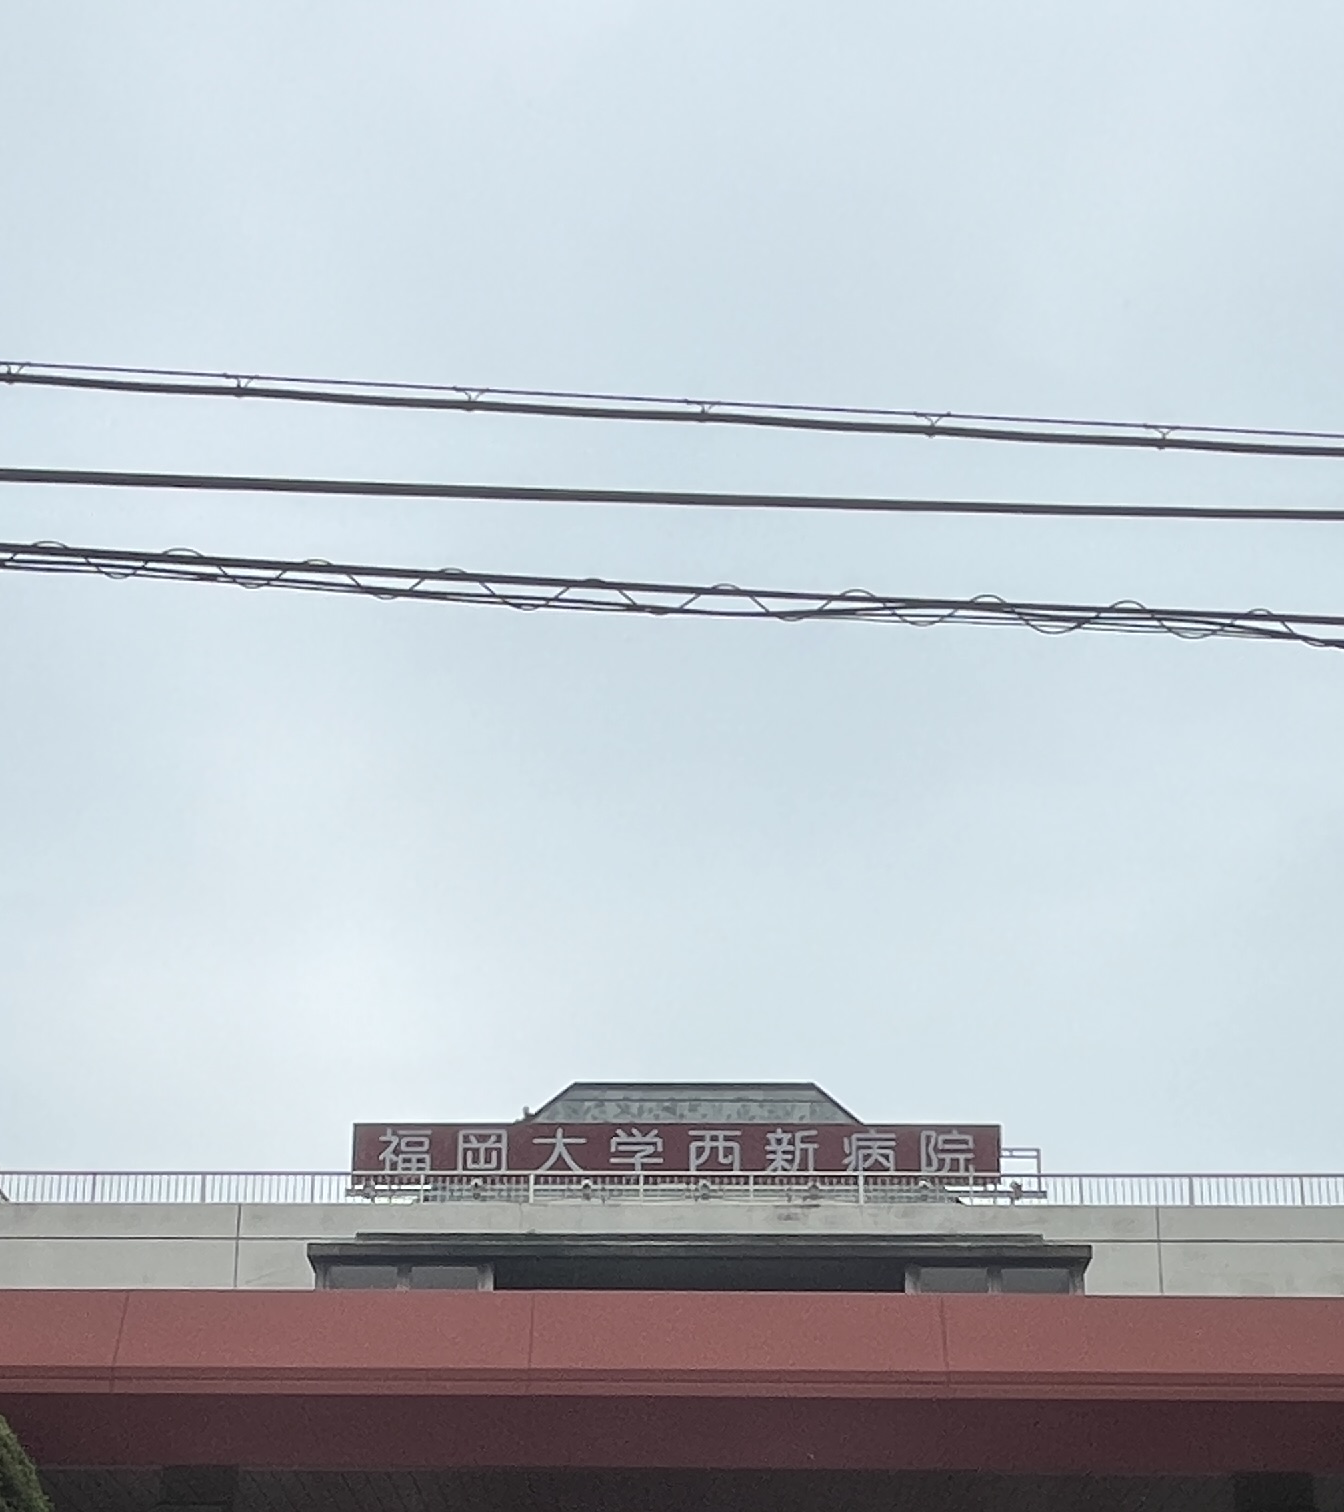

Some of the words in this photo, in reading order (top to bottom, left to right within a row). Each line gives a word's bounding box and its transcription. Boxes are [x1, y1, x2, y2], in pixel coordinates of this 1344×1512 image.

[378, 1126, 976, 1173] 福岡大学西新病院
